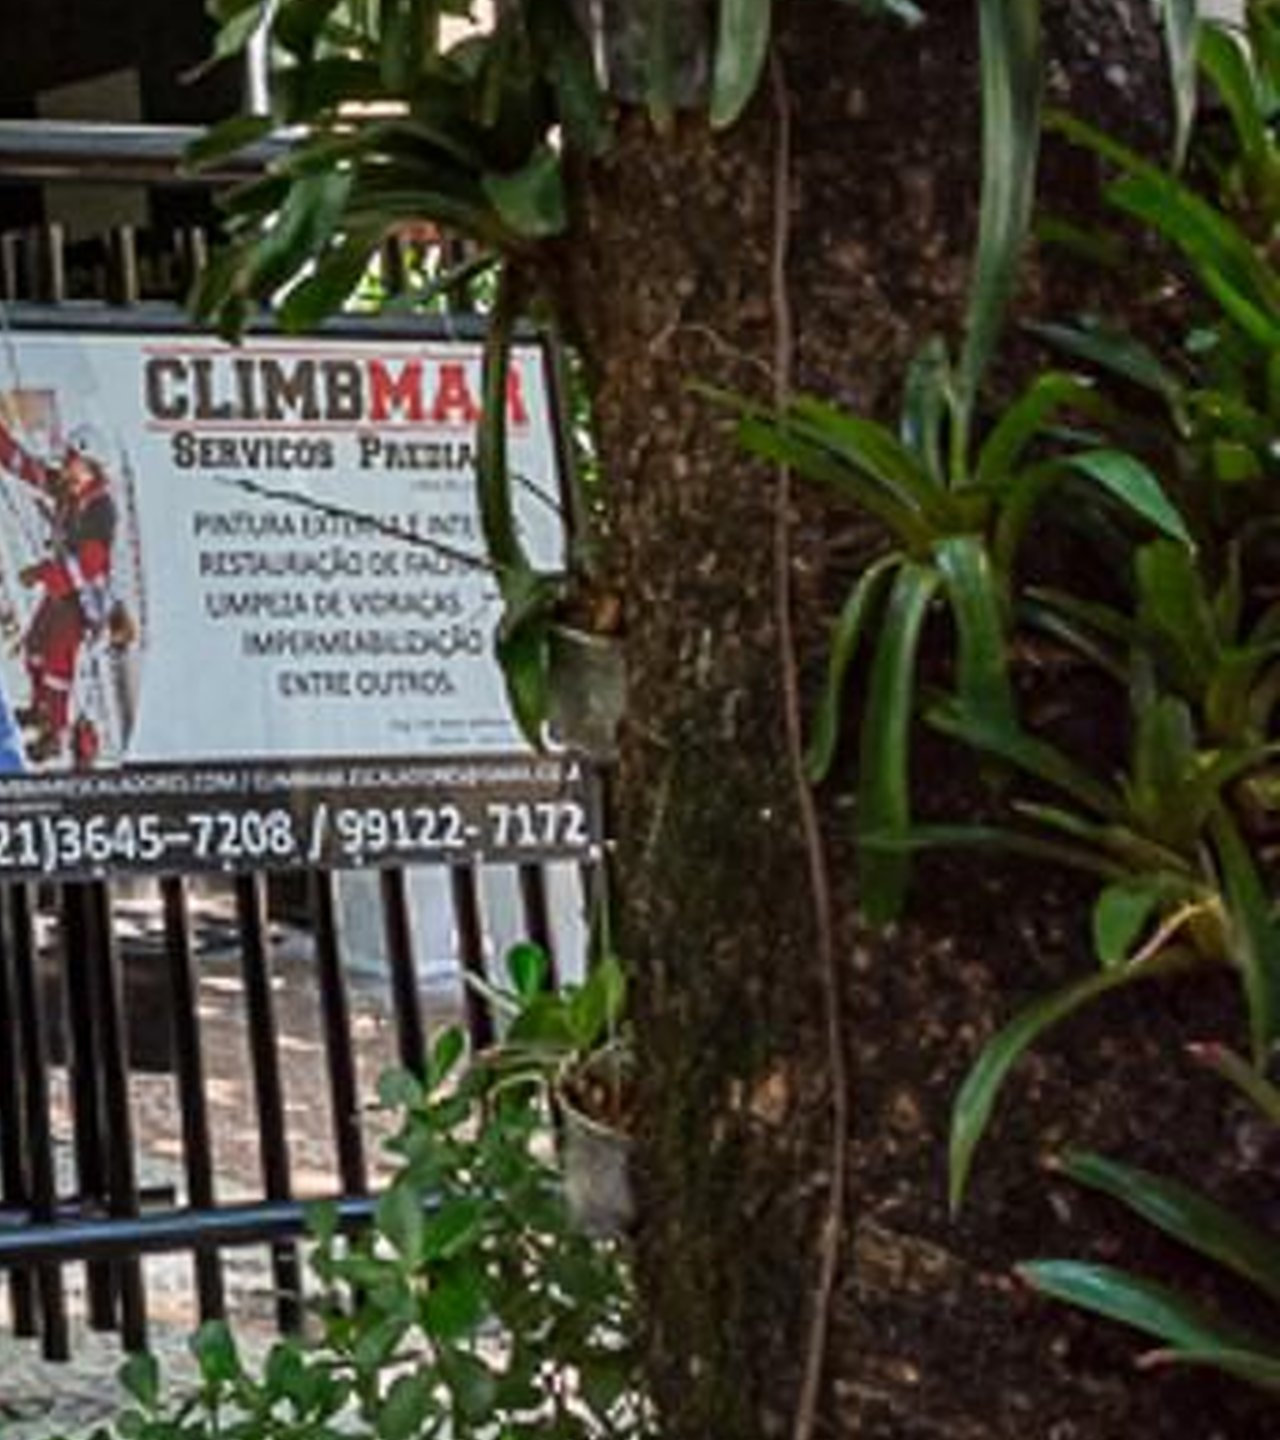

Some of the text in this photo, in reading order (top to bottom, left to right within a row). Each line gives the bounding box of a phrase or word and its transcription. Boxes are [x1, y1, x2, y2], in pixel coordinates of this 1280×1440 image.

[199, 545, 362, 581] RESTAURAÇÃO
[368, 550, 400, 577] DE
[205, 592, 309, 619] LIMPEZA
[313, 592, 343, 619] DE
[242, 624, 484, 659] IMPERMEABILIZAÇÃO
[277, 669, 352, 698] ENTRE
[487, 801, 590, 848] 7172
